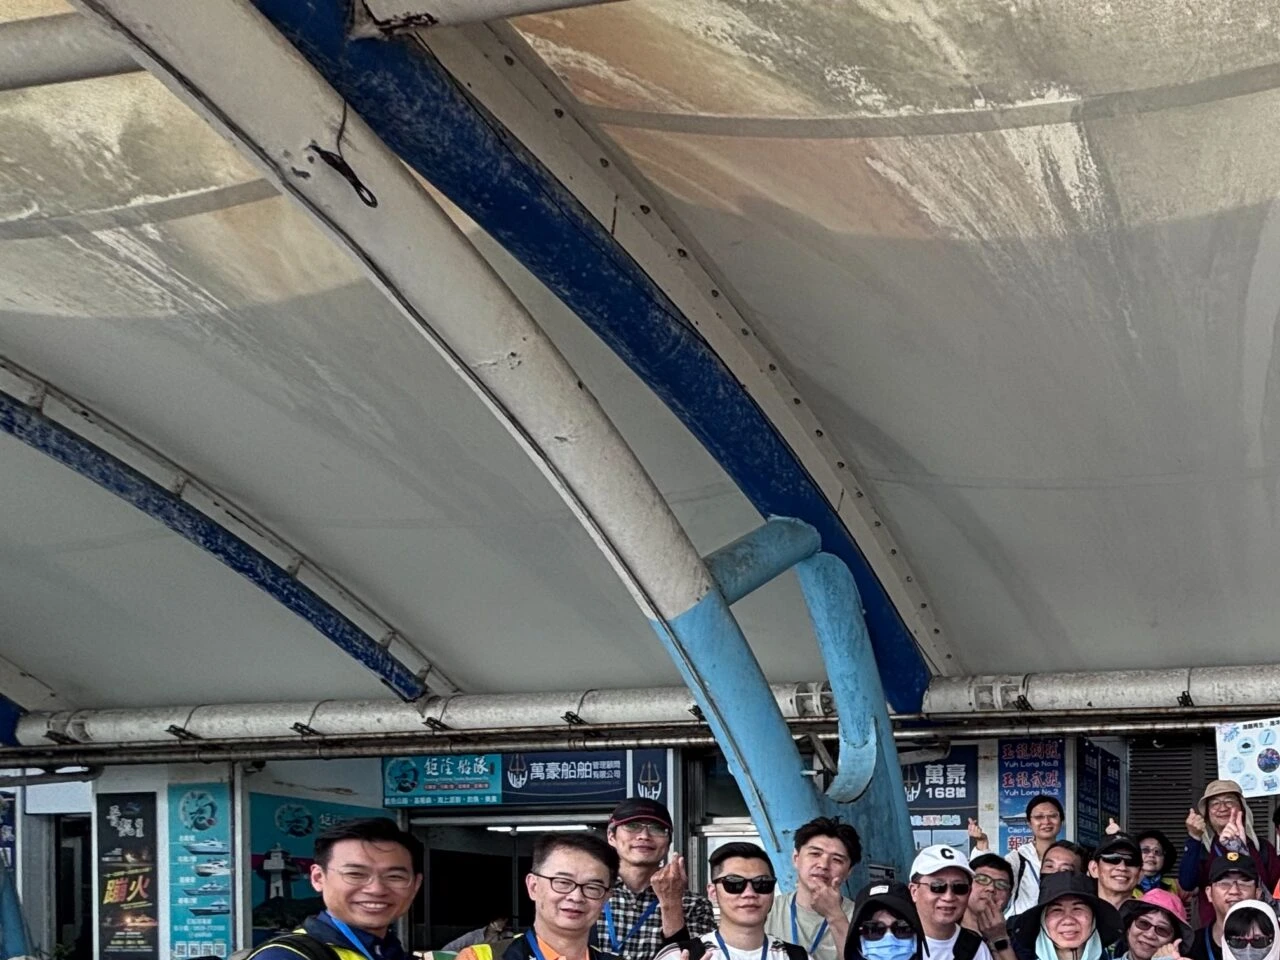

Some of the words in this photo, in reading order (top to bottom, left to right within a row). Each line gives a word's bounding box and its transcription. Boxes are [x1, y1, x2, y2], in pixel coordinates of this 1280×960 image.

[530, 761, 593, 780] 萬豪船舶
[925, 764, 966, 785] 萬豪
[925, 787, 966, 799] 168號
